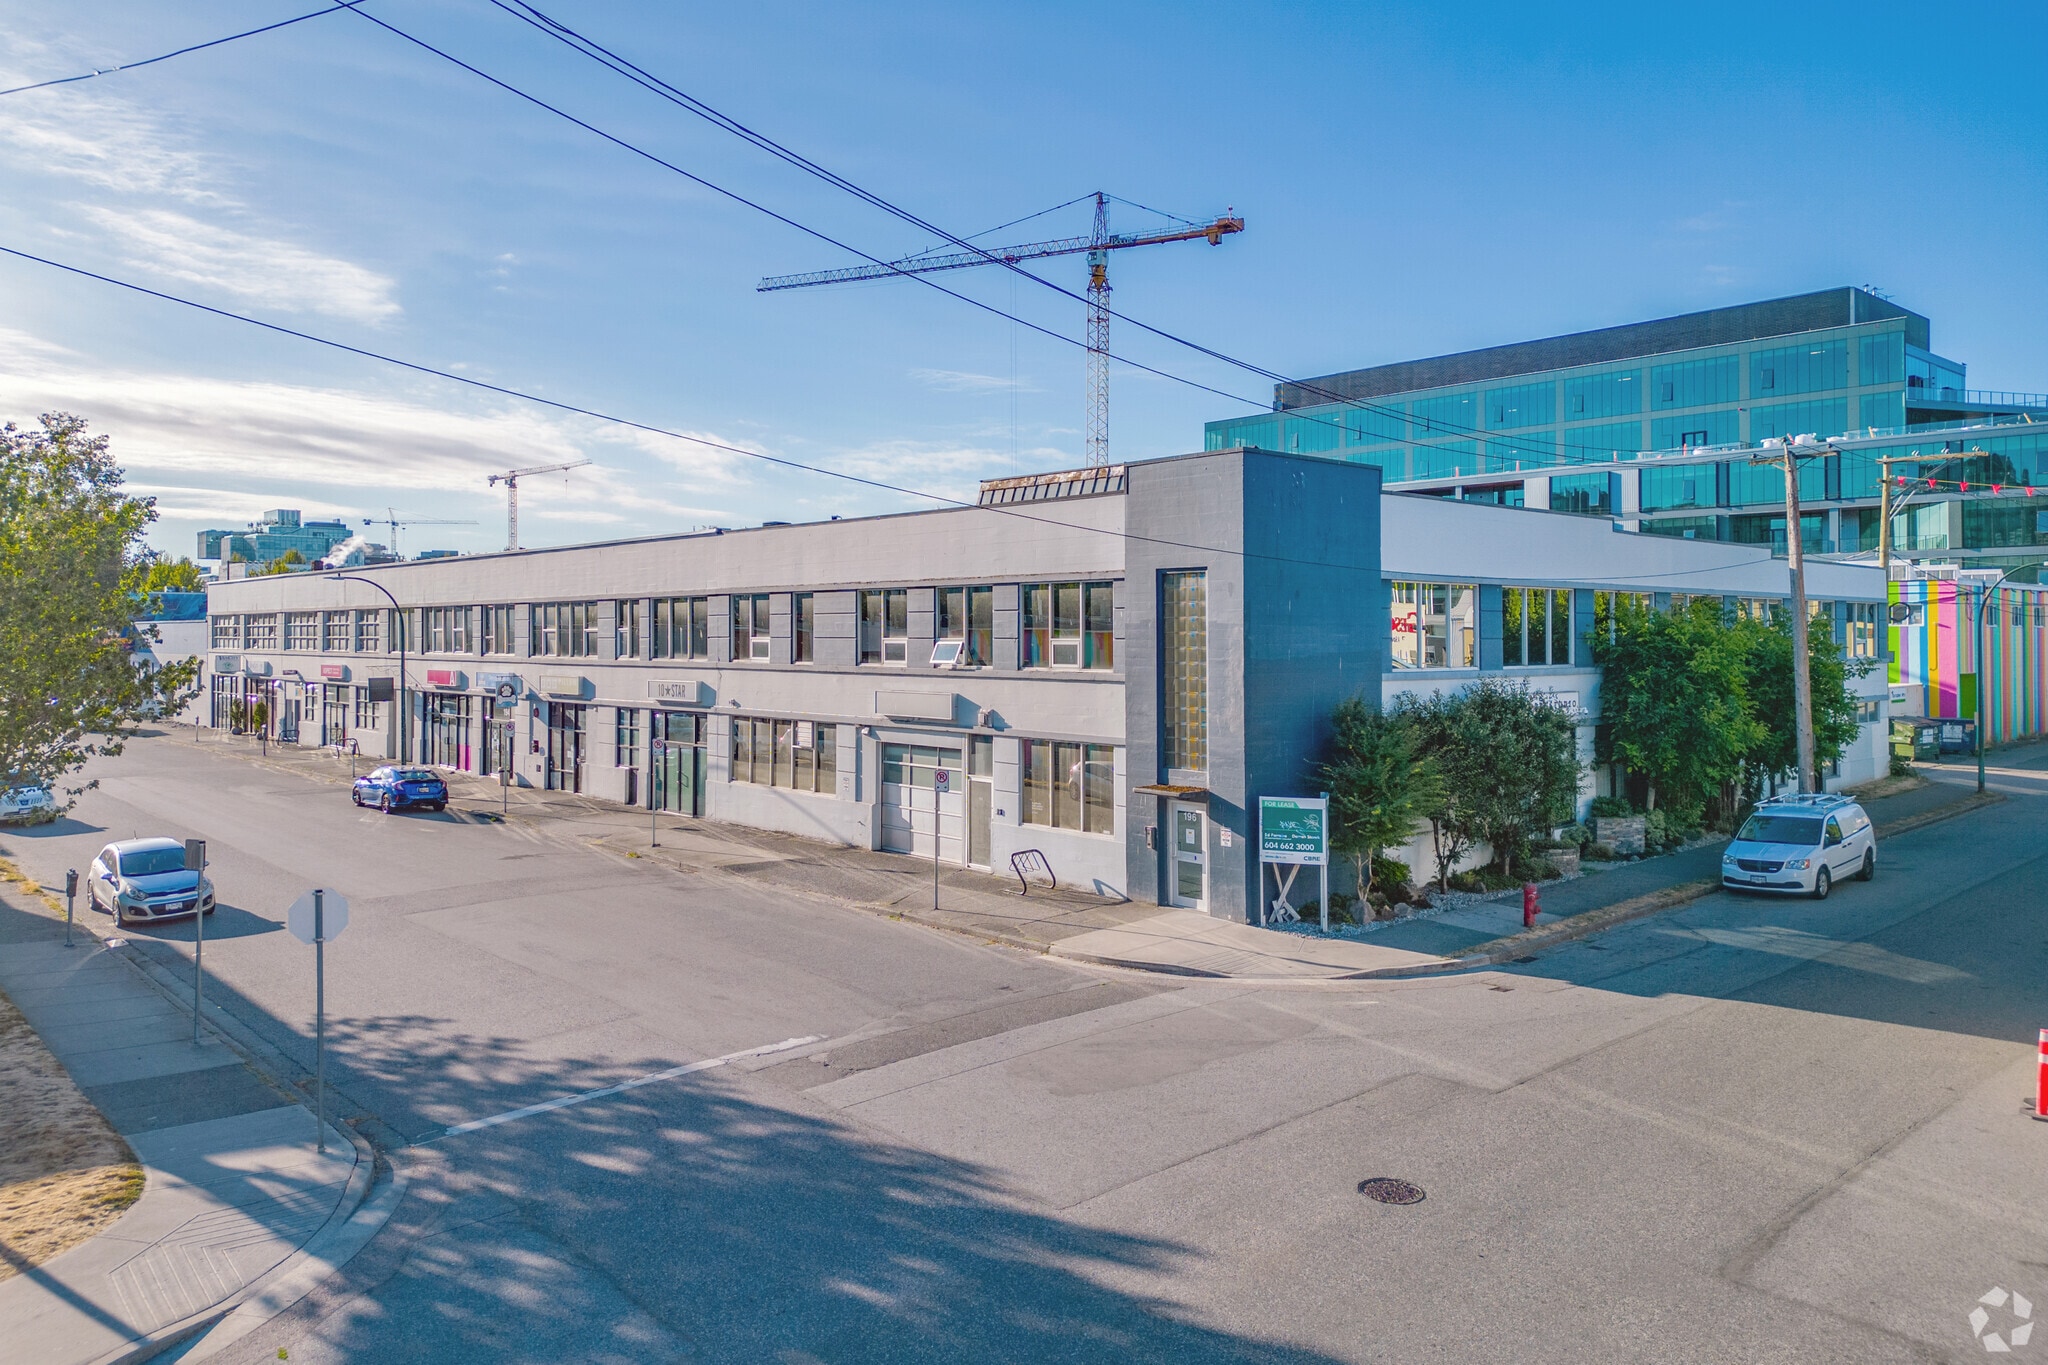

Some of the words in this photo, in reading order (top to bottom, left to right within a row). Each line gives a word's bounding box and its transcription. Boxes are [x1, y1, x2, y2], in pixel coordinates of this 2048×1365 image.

[1183, 812, 1197, 822] 196
[1264, 841, 1279, 849] 604
[1280, 842, 1294, 850] 662
[1295, 843, 1315, 851] 3000
